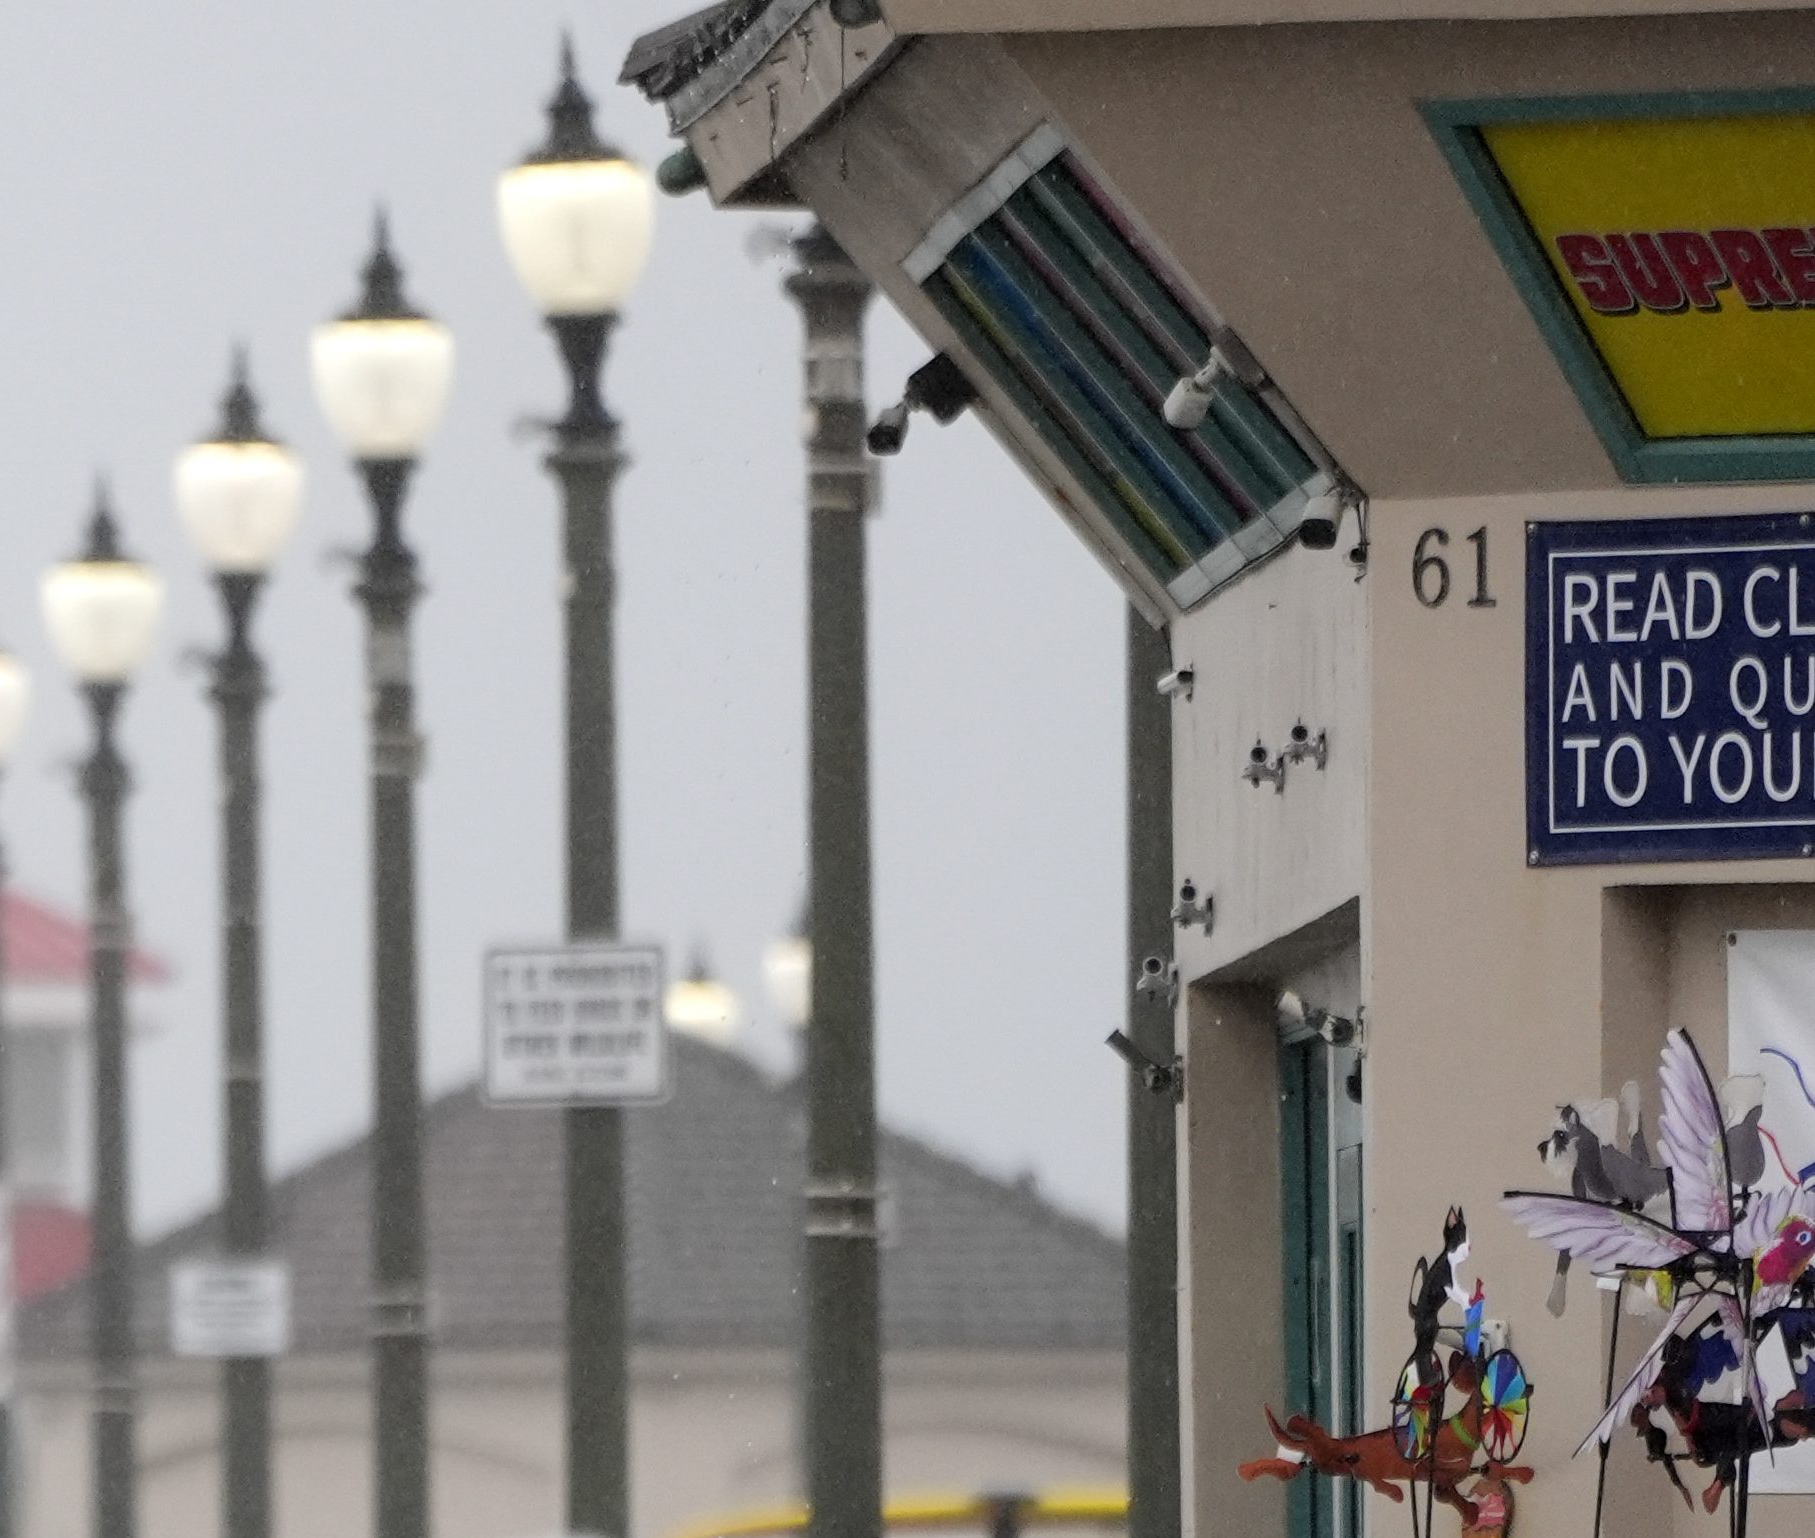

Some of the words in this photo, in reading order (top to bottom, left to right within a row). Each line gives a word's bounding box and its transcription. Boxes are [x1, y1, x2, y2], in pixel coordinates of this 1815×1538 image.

[1554, 228, 1815, 313] SUPRE
[1412, 526, 1498, 609] 61
[1564, 570, 1723, 643] READ
[1744, 566, 1815, 639] CL
[1562, 661, 1694, 723] AND
[1729, 655, 1815, 730] QU
[1562, 736, 1648, 808] TO
[1668, 731, 1815, 805] YOU
